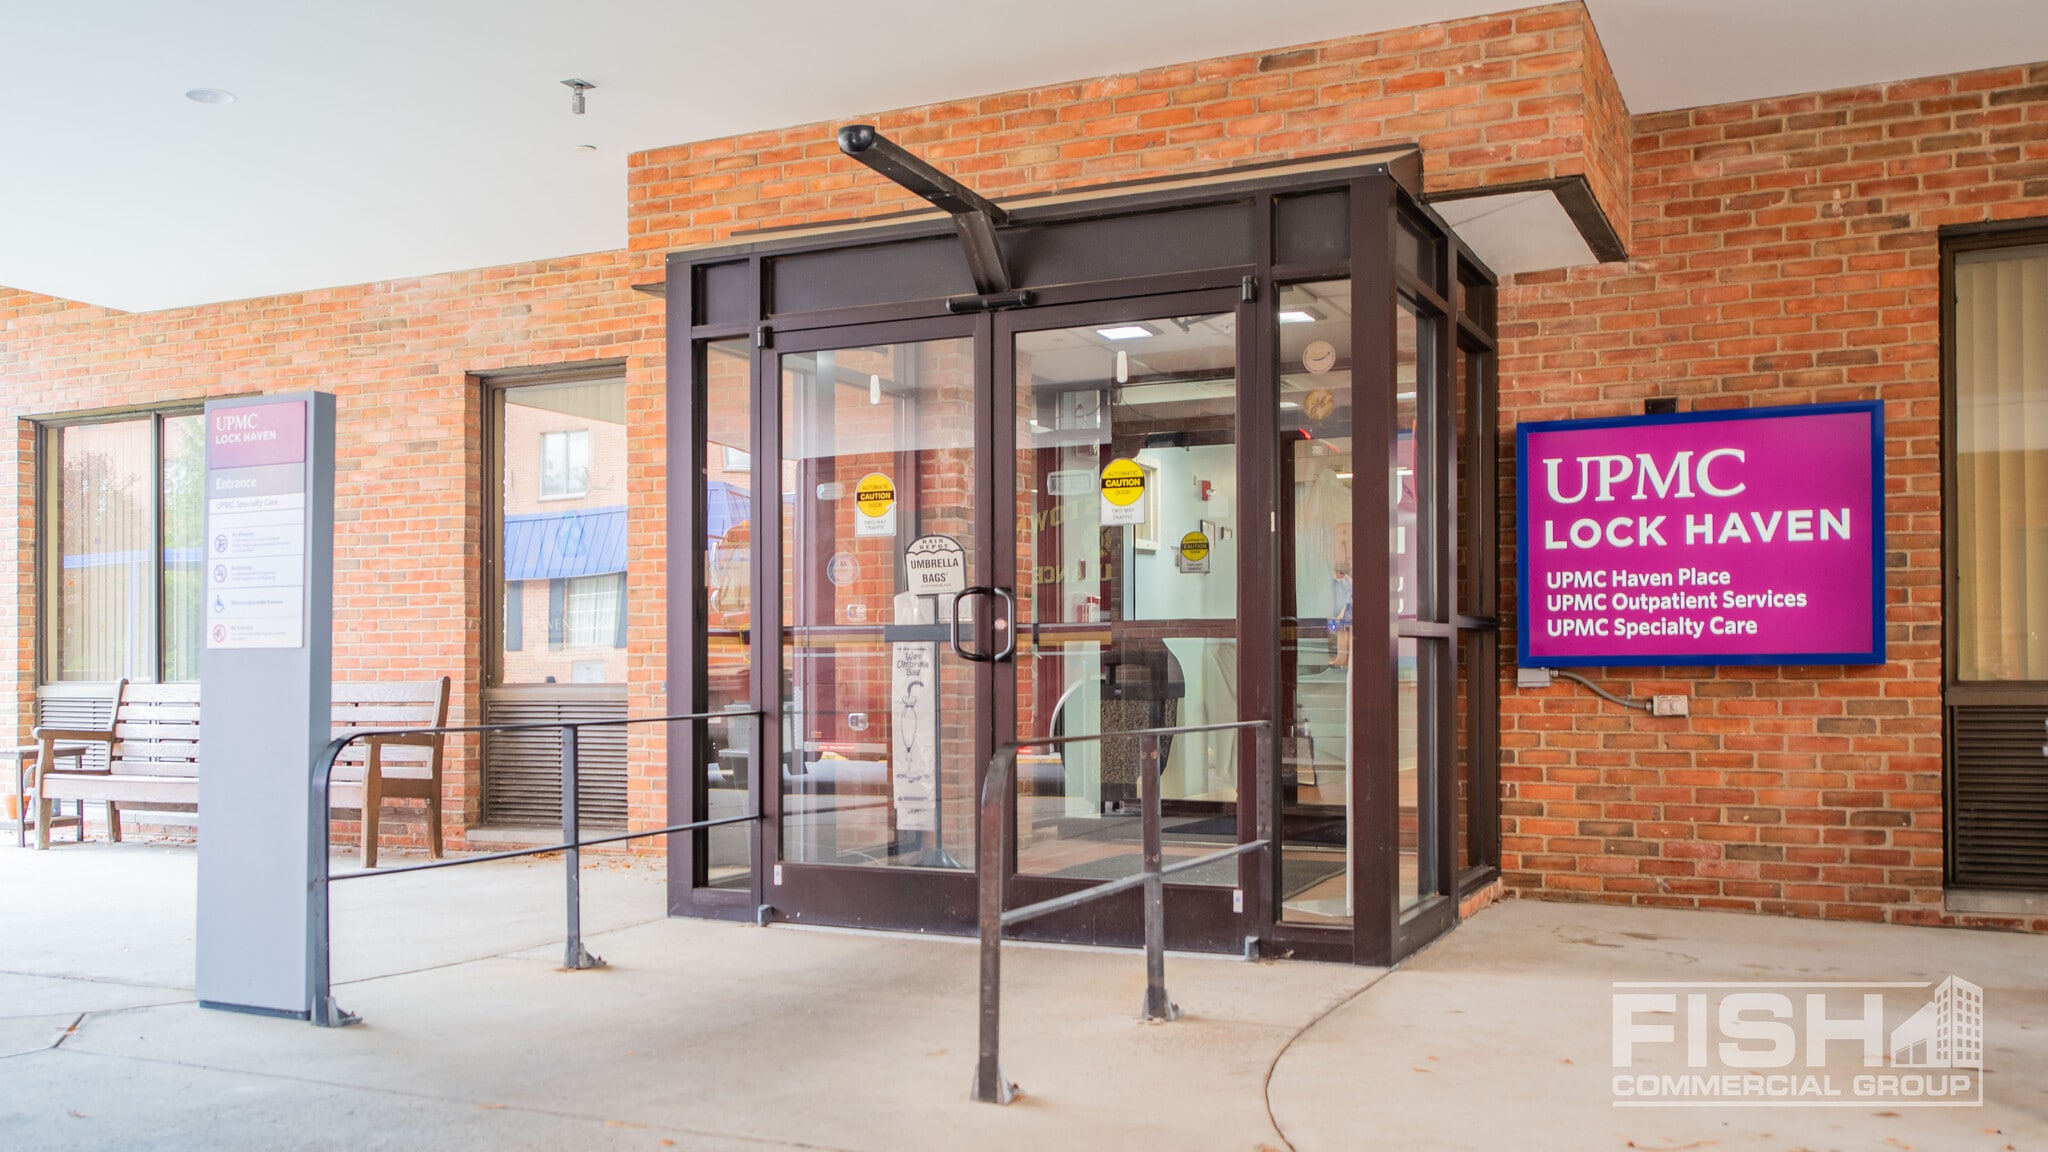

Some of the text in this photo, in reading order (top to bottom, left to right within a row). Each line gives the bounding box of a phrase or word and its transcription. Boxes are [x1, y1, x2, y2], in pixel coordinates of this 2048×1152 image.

[215, 413, 258, 431] UPMC
[215, 430, 277, 445] LOCK HAVEN
[215, 478, 257, 490] Entrance
[1105, 478, 1141, 487] CAUTION
[1543, 449, 1746, 504] UPMC
[860, 492, 891, 501] CAUTION
[1545, 508, 1850, 549] LOCK HAVEN
[910, 557, 959, 570] UMBRELLA
[1547, 567, 1731, 589] UPMC Haven Place
[1547, 589, 1808, 614] UPMC Outpatient Services
[1547, 616, 1758, 639] UPMC Specialty Care
